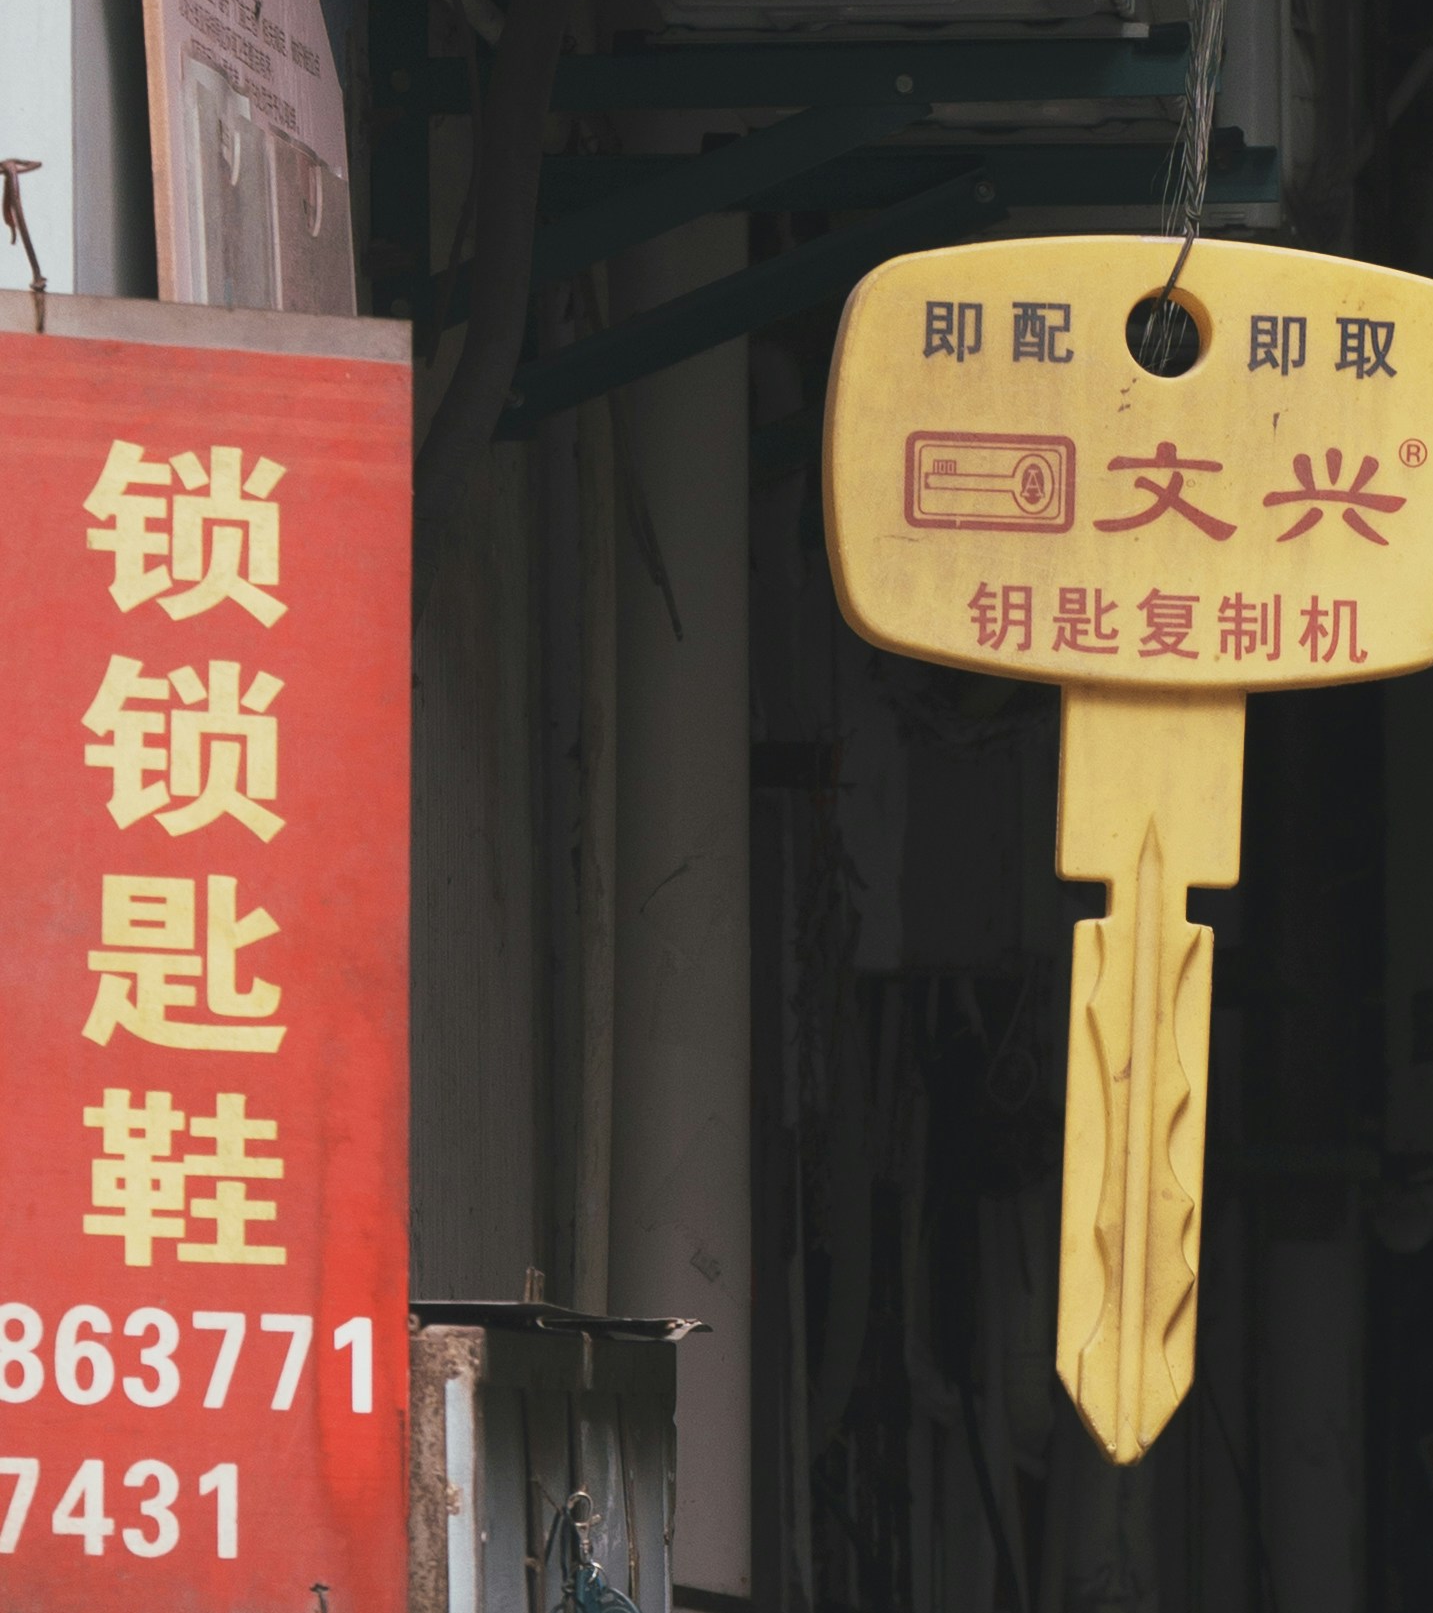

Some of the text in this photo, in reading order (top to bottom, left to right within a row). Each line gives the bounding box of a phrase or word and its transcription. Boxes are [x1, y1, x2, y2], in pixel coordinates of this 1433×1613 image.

[921, 300, 1398, 378] 即配 即取
[967, 581, 1369, 664] 钥匙复制机
[0, 1303, 374, 1414] 863771
[0, 1457, 239, 1560] 7431
